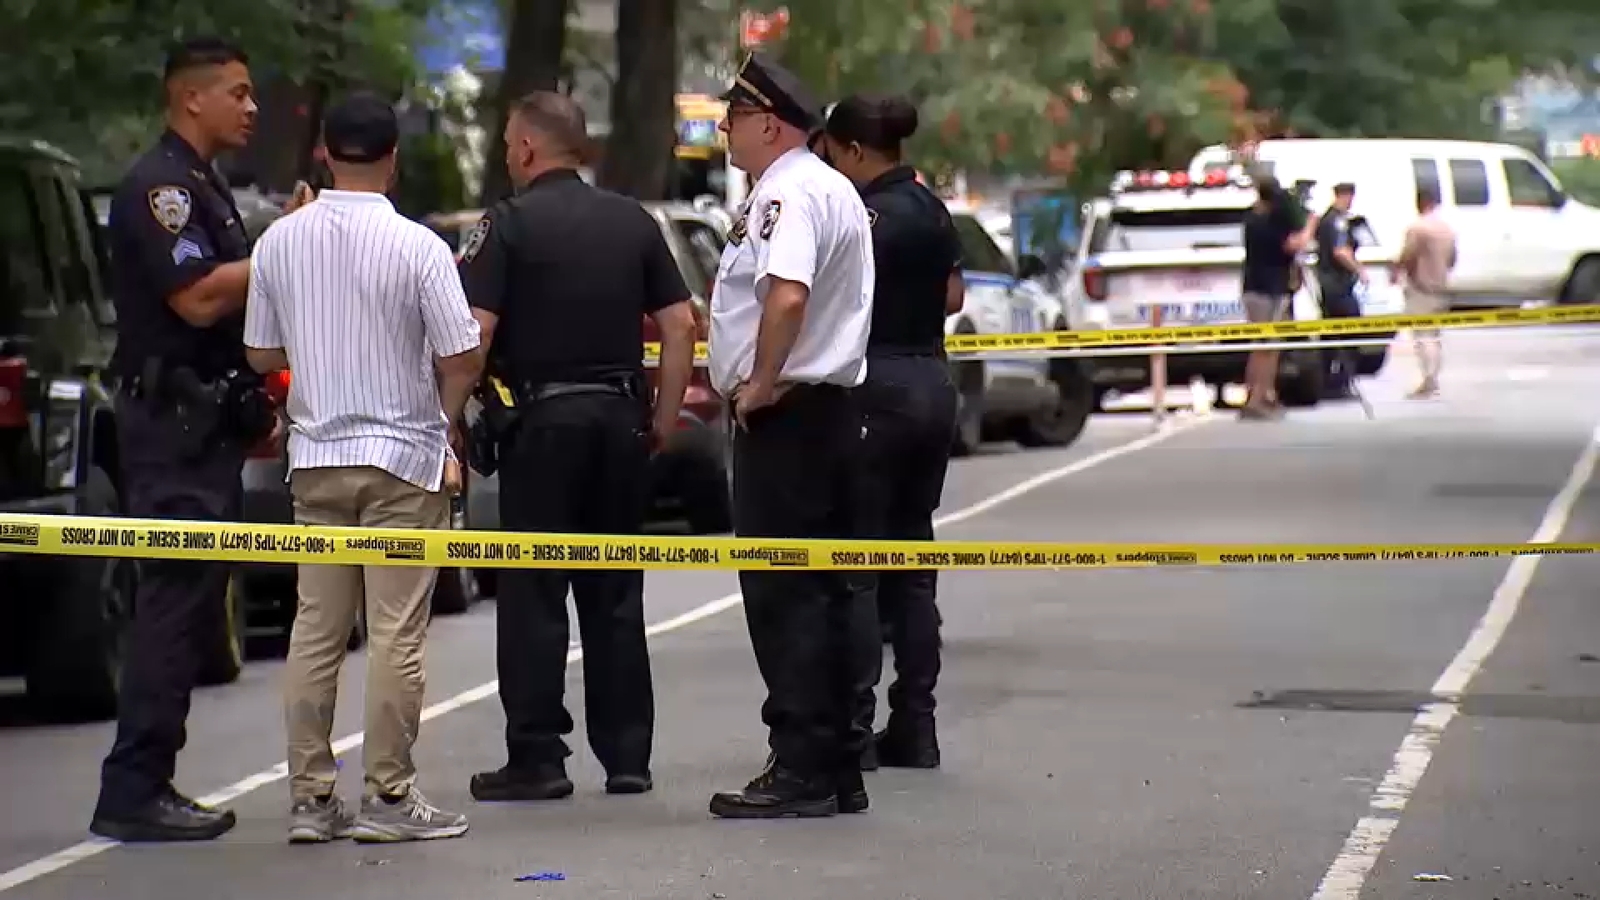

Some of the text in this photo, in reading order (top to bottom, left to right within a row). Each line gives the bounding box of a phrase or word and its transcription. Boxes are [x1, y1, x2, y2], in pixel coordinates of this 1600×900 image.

[61, 526, 96, 544] CROSS
[98, 528, 118, 546] NOT
[121, 529, 135, 546] DO
[147, 530, 180, 548] SCENE
[183, 531, 216, 549] CRIME
[220, 530, 252, 552] (8477)
[254, 533, 335, 554] 1-800-577-TIPS
[447, 541, 481, 559] CROSS
[484, 542, 504, 559] NOT
[506, 543, 520, 559] DO
[532, 544, 565, 561] SCENE
[568, 544, 600, 561] CRIME
[604, 542, 636, 563] (8477)
[639, 546, 719, 563] 1-800-577-TIPS
[831, 551, 865, 565] CROSS
[868, 551, 888, 565] NOT
[891, 552, 905, 565] DO
[916, 551, 949, 565] SCENE
[952, 552, 985, 565] CRIME
